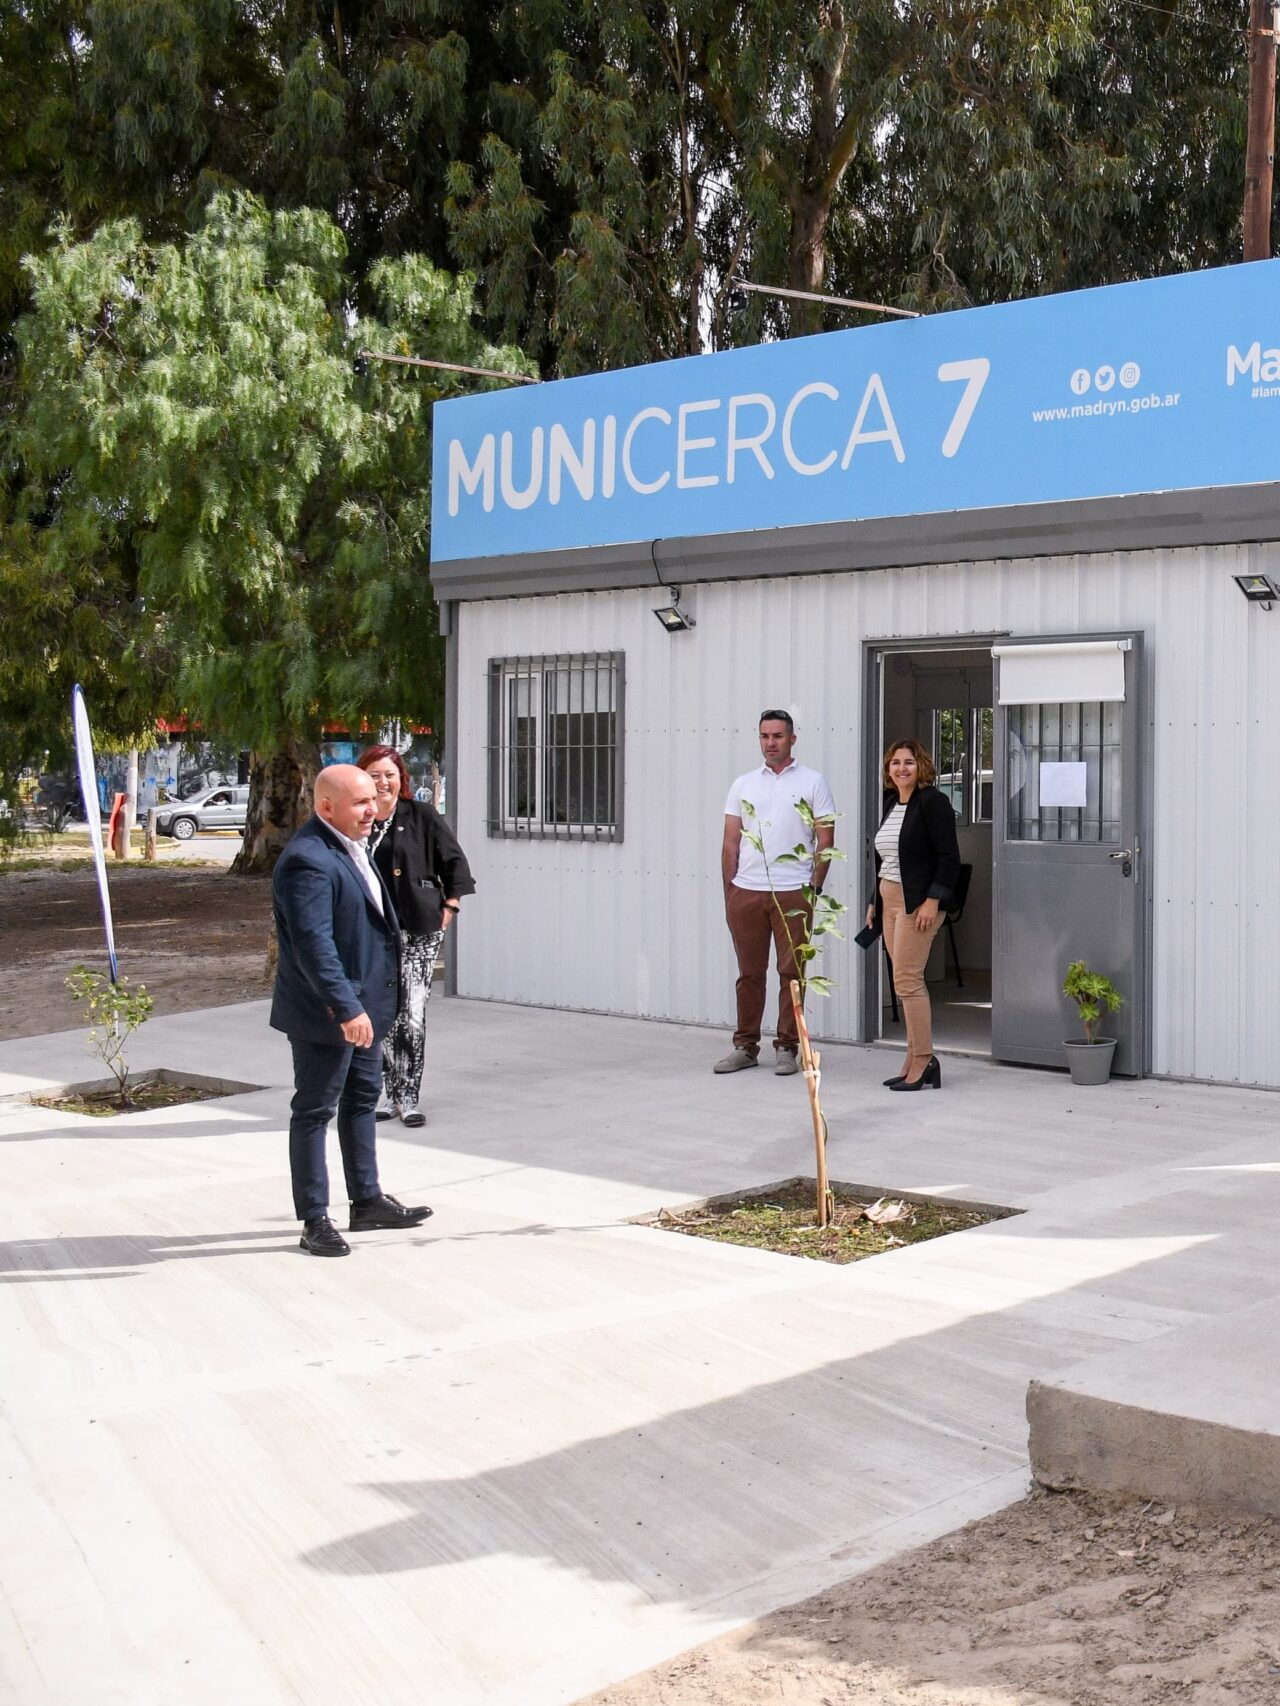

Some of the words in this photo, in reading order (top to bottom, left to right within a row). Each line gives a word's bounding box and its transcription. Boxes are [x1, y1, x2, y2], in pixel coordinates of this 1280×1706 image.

[448, 373, 905, 517] MUNICERCA
[937, 357, 991, 458] 7
[1032, 392, 1181, 423] www.madryn.gob.ar
